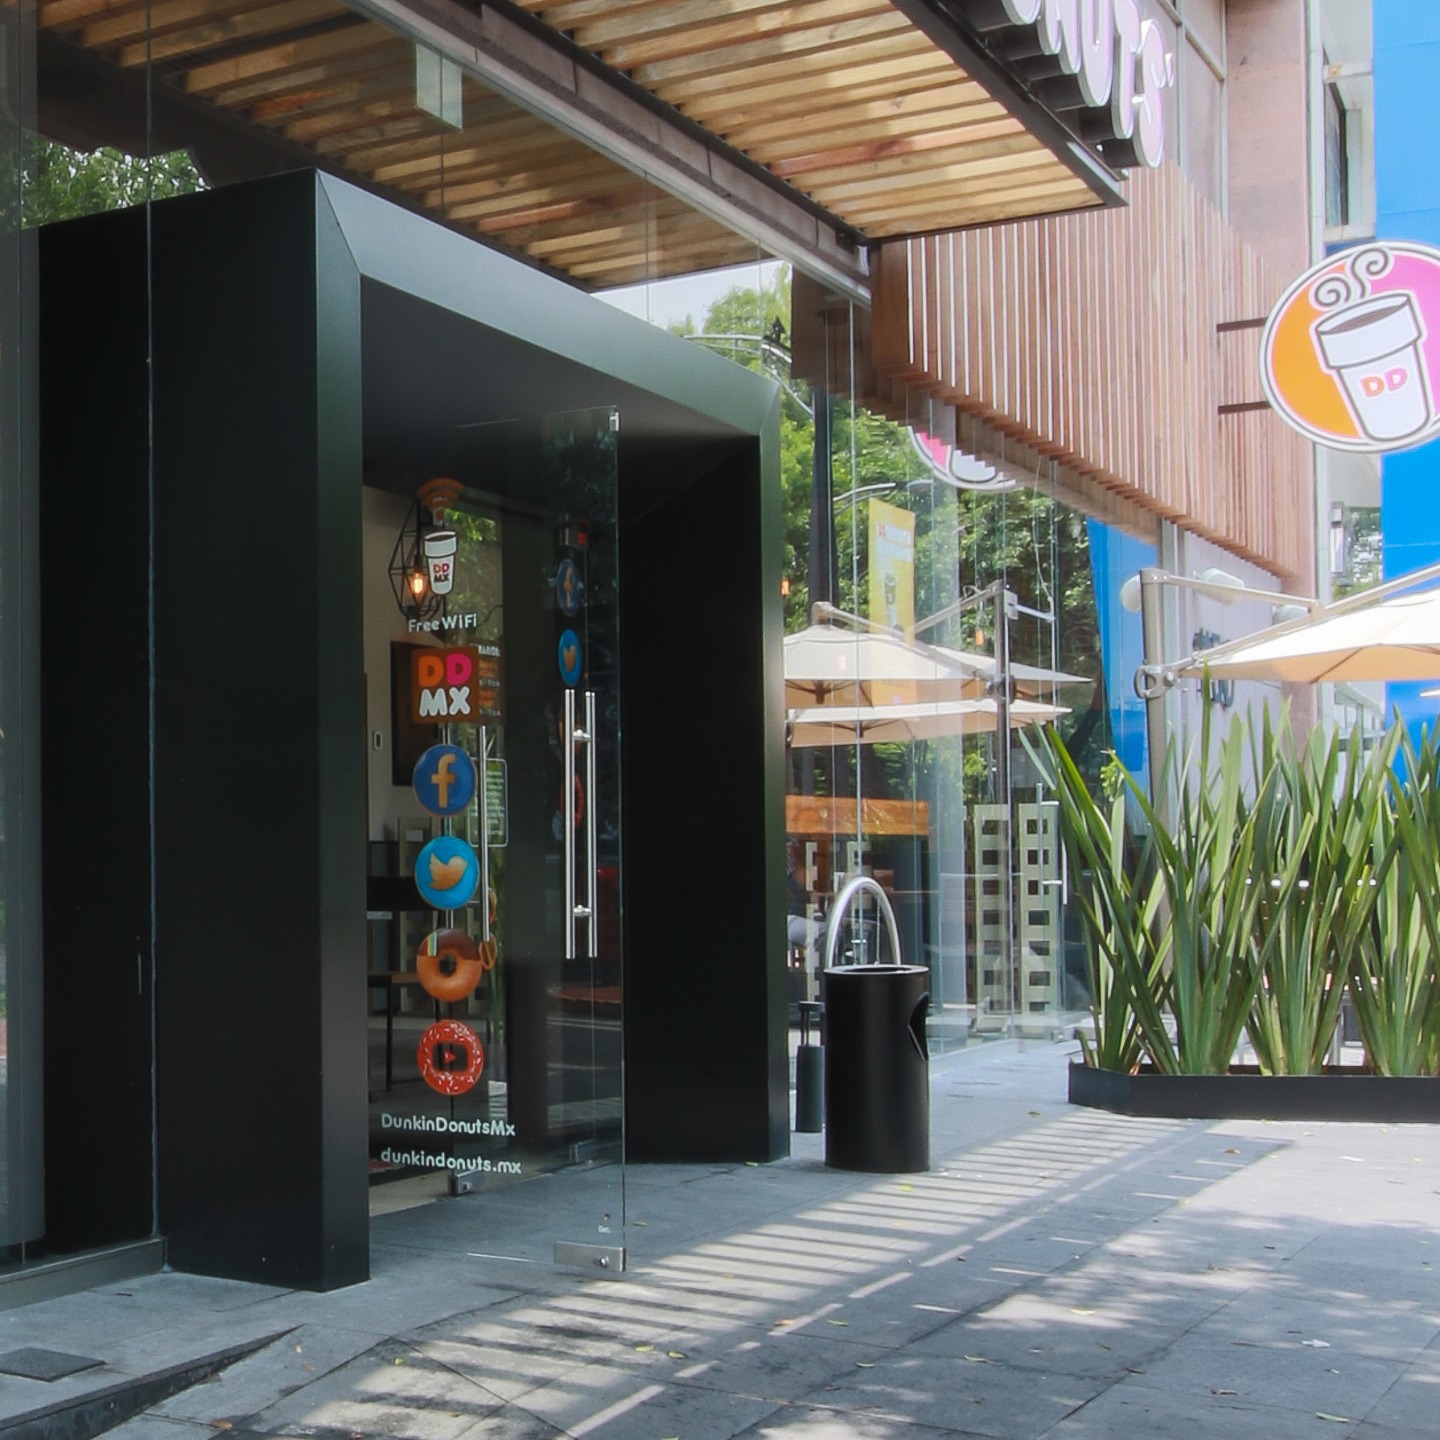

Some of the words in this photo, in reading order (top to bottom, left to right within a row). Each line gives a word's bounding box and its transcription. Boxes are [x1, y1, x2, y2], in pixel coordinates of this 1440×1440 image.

[1360, 366, 1408, 398] DD
[418, 653, 472, 687] DD
[419, 686, 471, 717] MX
[381, 1113, 516, 1137] DunkinDonutsMx
[380, 1147, 522, 1174] dunkindonuts.mx
